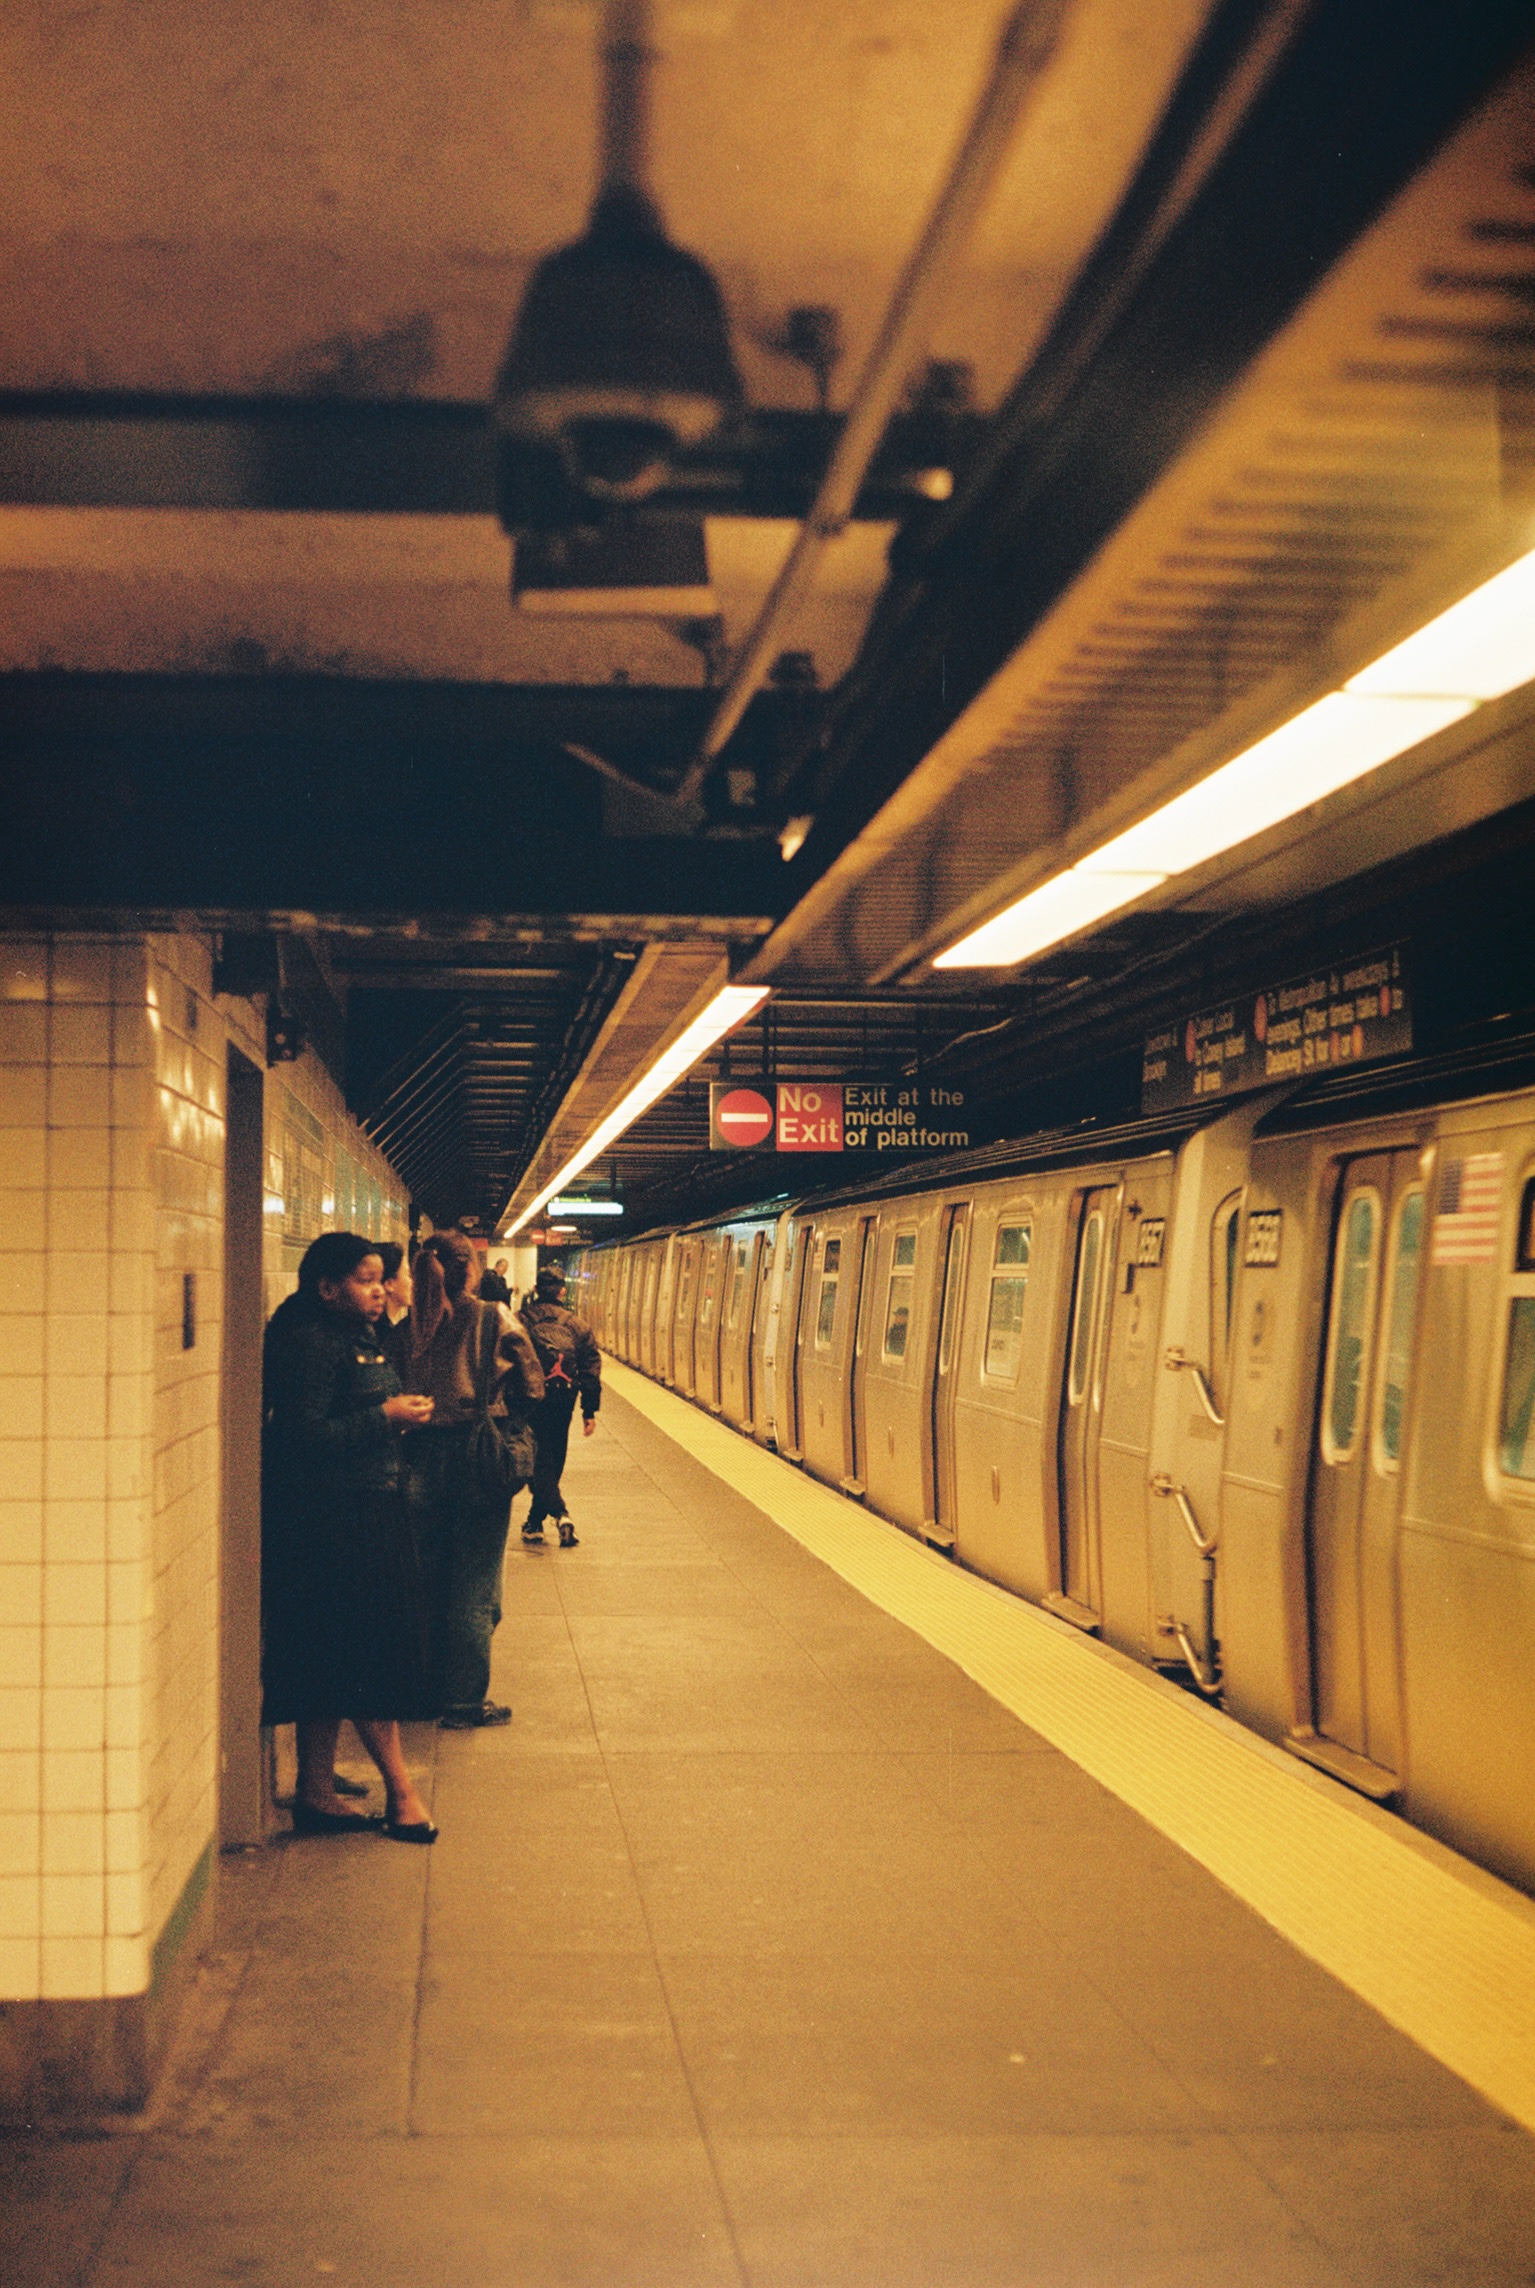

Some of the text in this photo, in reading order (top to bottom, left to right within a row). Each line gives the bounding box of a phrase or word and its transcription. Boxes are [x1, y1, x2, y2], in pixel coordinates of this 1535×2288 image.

[779, 1087, 822, 1112] No
[845, 1088, 964, 1106] Exit at the
[845, 1109, 916, 1126] middle
[779, 1118, 838, 1143] Exit
[845, 1127, 969, 1150] of platform
